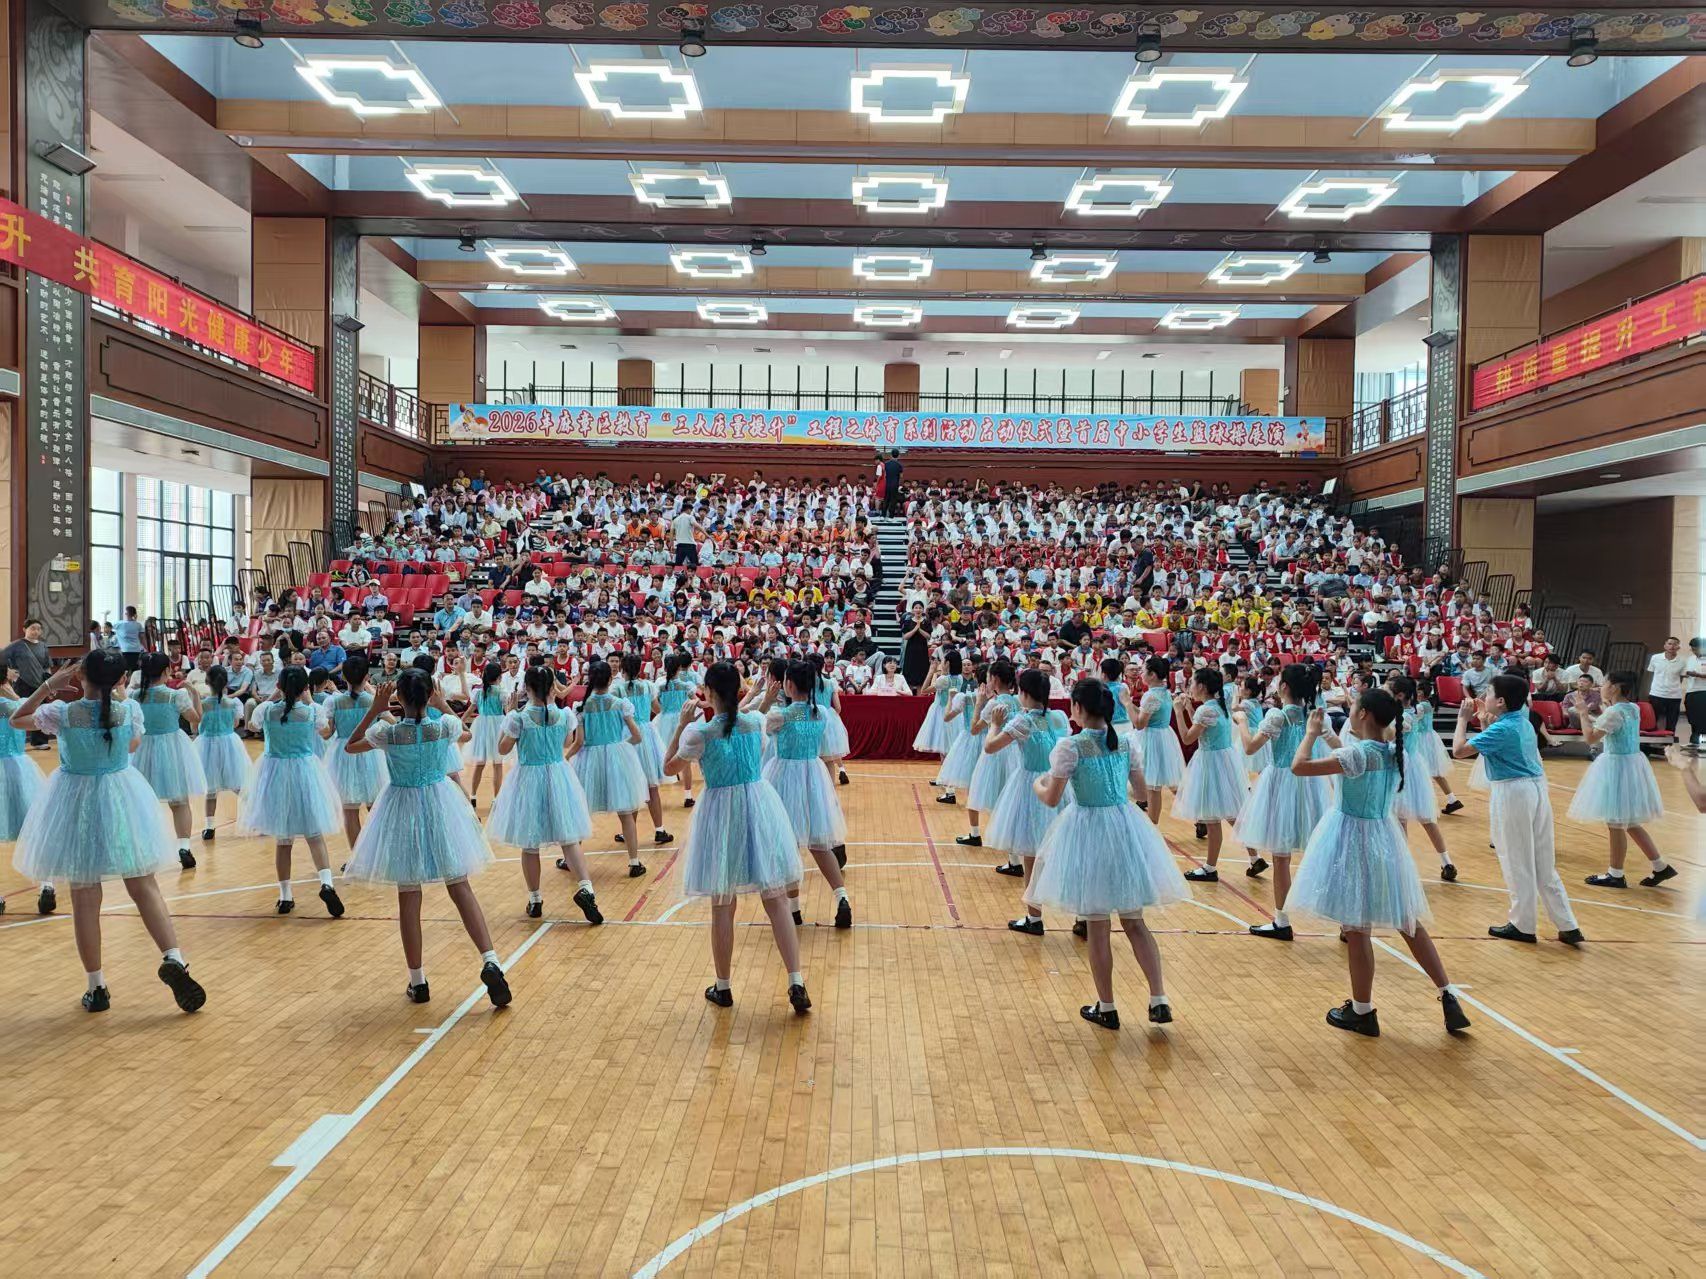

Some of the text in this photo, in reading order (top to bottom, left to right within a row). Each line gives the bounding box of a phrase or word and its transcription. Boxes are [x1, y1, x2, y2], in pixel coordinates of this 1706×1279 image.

[73, 246, 295, 375] 共育阳光健康少年
